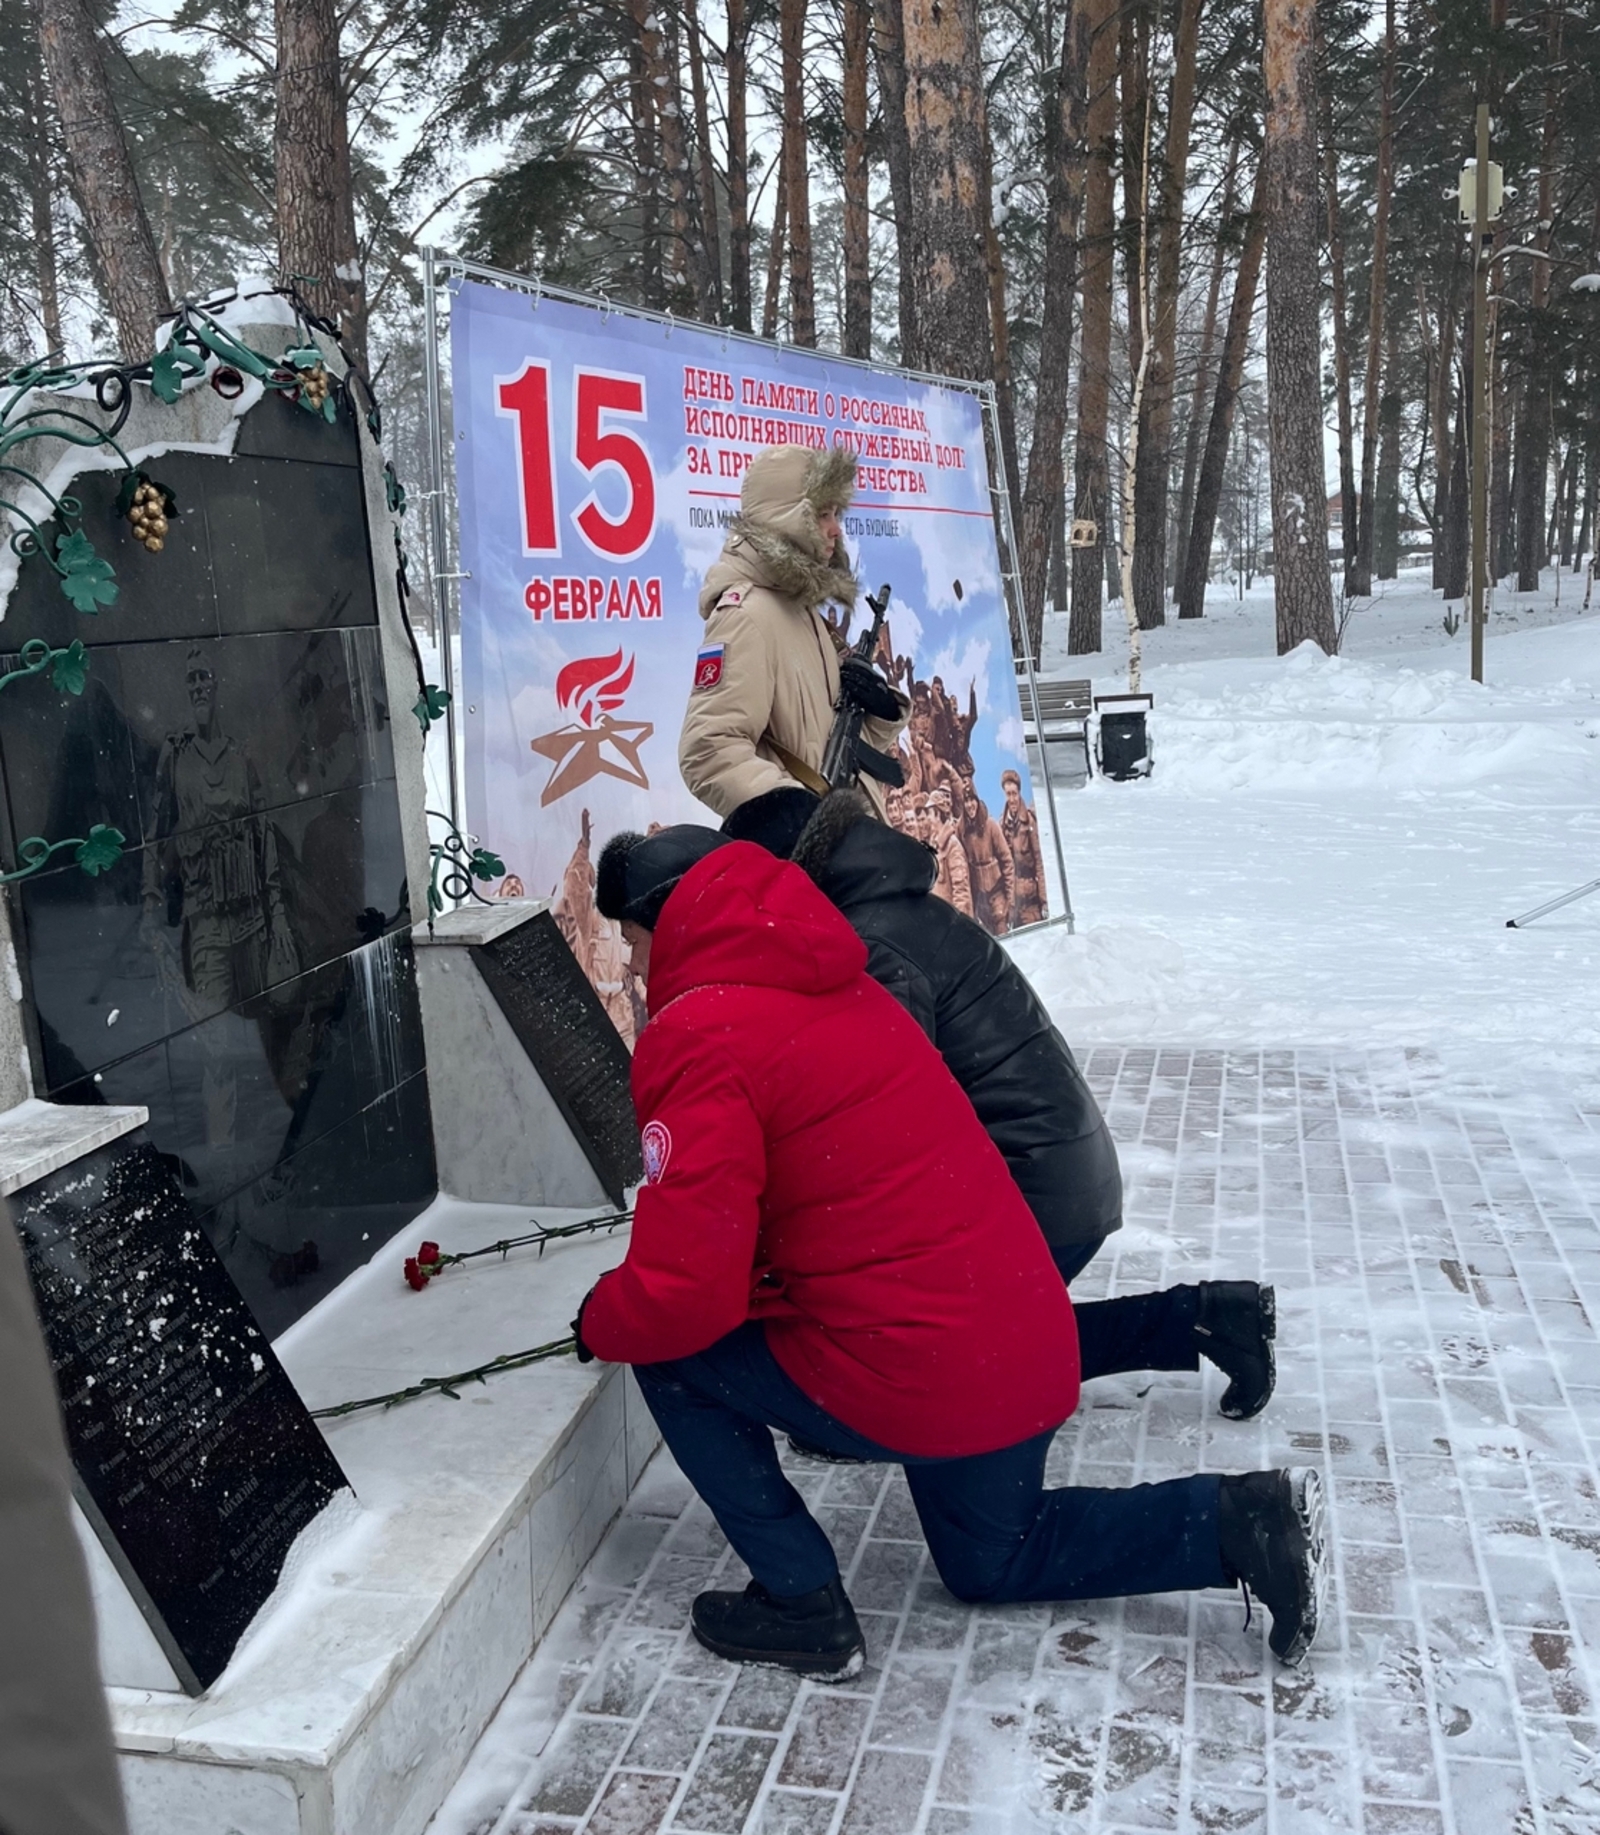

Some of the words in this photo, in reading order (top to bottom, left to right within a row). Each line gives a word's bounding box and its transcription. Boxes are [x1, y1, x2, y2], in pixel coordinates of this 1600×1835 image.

[683, 366, 734, 401] ДЕНЬ
[741, 378, 819, 415] ПАМЯТИ
[824, 393, 836, 418] О
[840, 395, 931, 438] РОССИЯНАХ,
[685, 406, 827, 450] ИСПОЛНЯВШИХ
[832, 430, 933, 463] СЛУЖЕБНЫЙ
[496, 361, 656, 558] 15
[687, 446, 712, 475] ЗА
[857, 466, 927, 494] ЕЧЕСТВА
[689, 507, 715, 529] ПОКА
[845, 517, 865, 536] ЕСТЬ
[865, 518, 900, 538] БУДУЩЕЕ
[525, 578, 662, 622] ФЕВРАЛЯ
[217, 1477, 258, 1520] Абхазия
